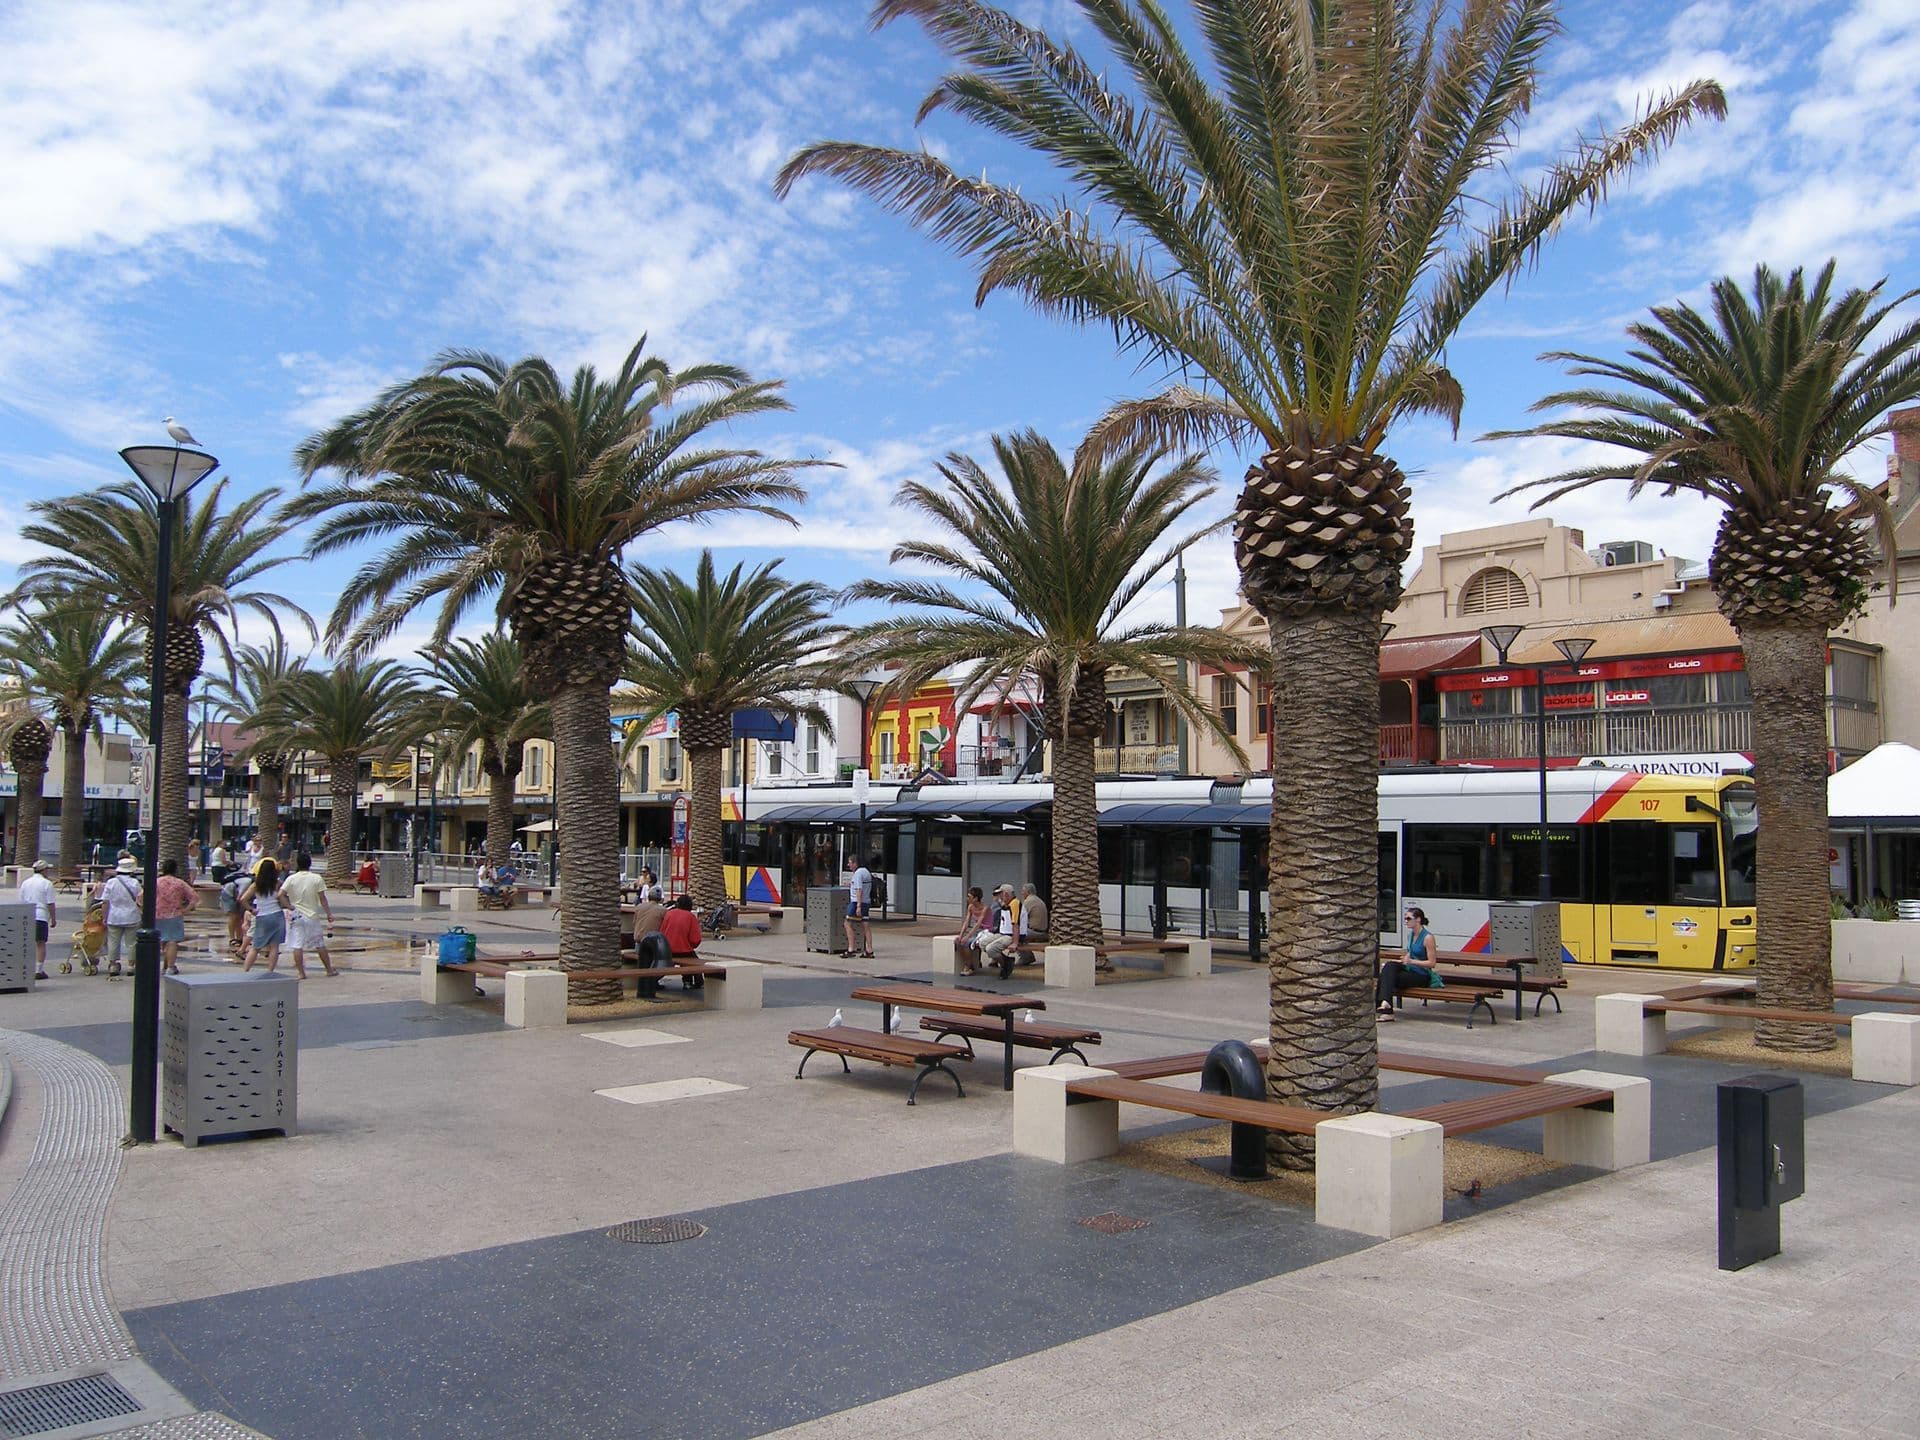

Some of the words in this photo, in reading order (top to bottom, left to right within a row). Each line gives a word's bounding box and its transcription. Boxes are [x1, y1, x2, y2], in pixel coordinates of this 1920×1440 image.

[1668, 660, 1701, 669] LIQUID
[1481, 674, 1509, 683] LIQUID
[1606, 693, 1648, 702] LIQUID
[1640, 799, 1660, 811] 107
[276, 1001, 285, 1078] HOLDFAST
